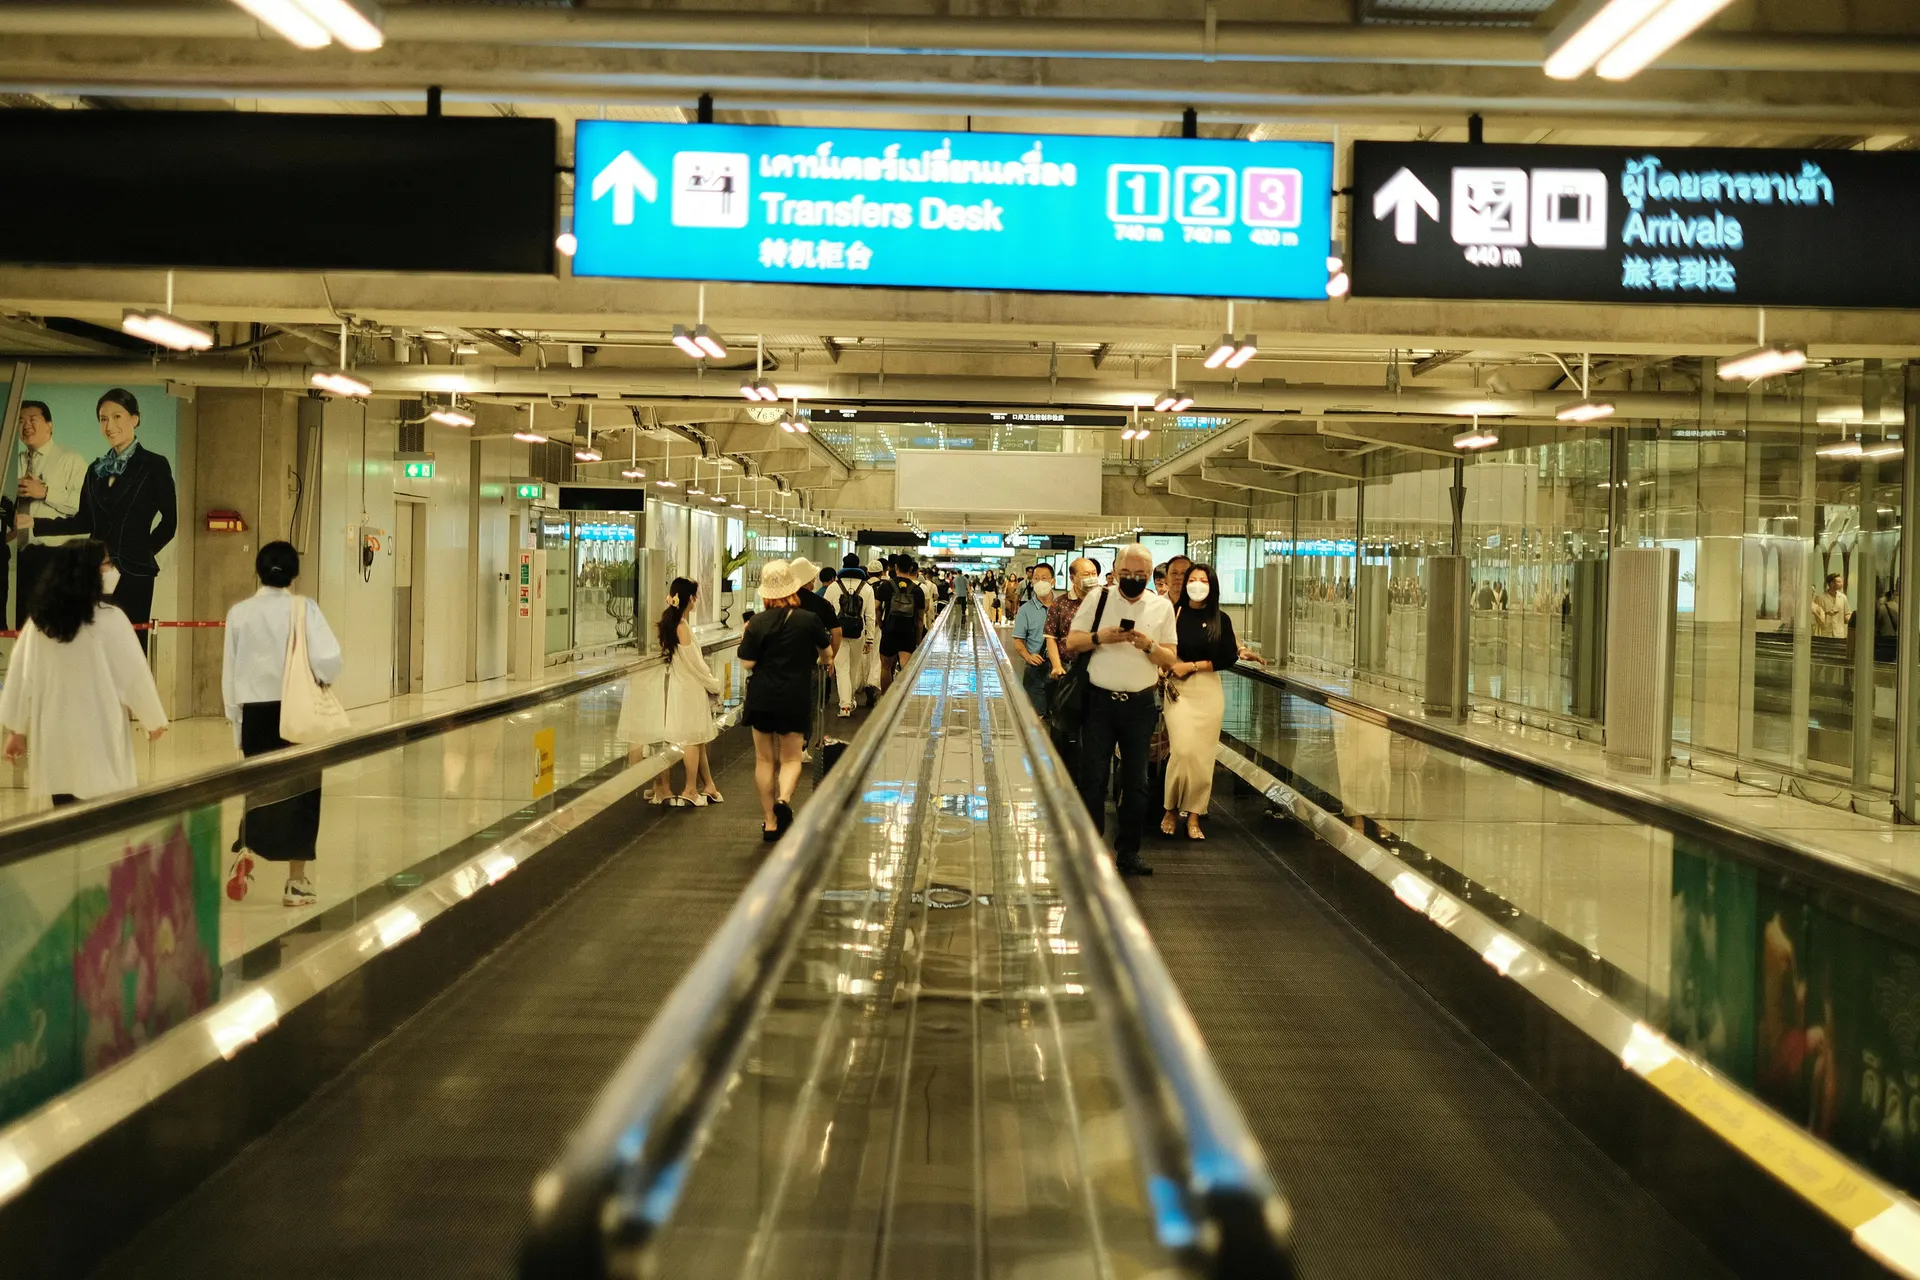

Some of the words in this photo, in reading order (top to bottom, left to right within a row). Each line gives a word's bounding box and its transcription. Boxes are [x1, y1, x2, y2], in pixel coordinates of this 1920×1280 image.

[1125, 174, 1146, 214] 1
[1190, 175, 1222, 216] 2
[1258, 178, 1286, 218] 3
[1621, 154, 1835, 208] ผู้โดยสารขาเข้า
[759, 191, 913, 229] Transfers
[919, 196, 1004, 231] Desk
[1622, 208, 1744, 250] Arrivals
[1502, 247, 1522, 268] m
[1621, 253, 1738, 293] 旅客到达
